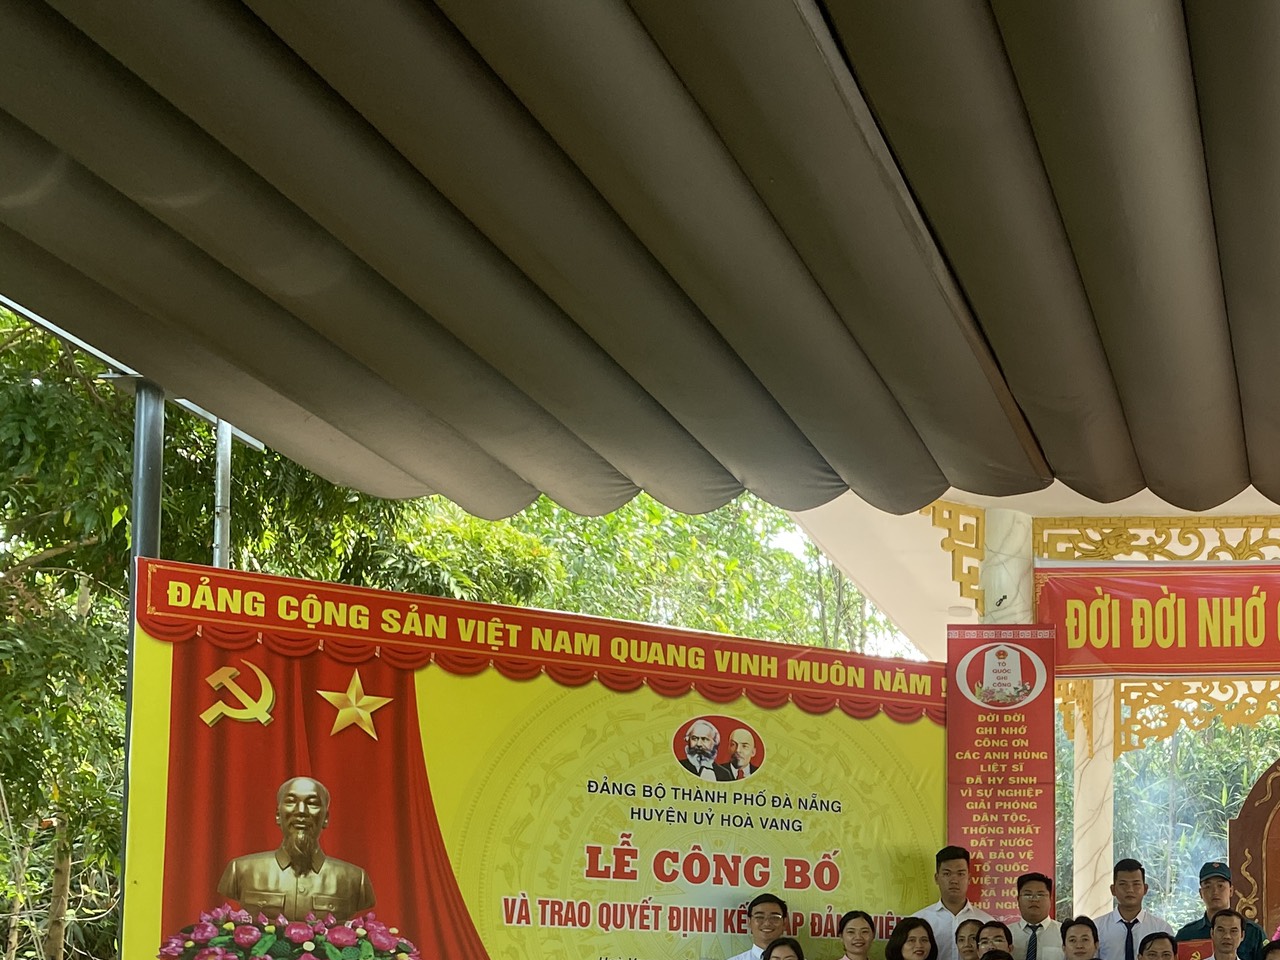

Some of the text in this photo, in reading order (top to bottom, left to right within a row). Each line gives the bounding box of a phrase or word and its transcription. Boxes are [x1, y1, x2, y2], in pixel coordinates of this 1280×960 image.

[1064, 584, 1120, 649] ĐỜI
[1131, 584, 1186, 649] ĐỜI
[1198, 584, 1267, 648] NHỚ
[167, 576, 265, 617] ĐẢNG
[277, 594, 370, 629] CỘNG
[380, 603, 447, 639] SẢN
[456, 617, 522, 650] VIỆT
[531, 628, 600, 657] NAM
[610, 637, 705, 670] QUANG
[713, 649, 778, 678] VINH
[786, 659, 866, 689] MUÔN
[873, 667, 932, 696] NĂM
[978, 712, 1026, 722] ĐỜI ĐỜI
[975, 725, 1027, 735] GHI NHỚ
[974, 737, 1010, 747] CÔNG
[955, 749, 1048, 760] CÁC ANH HÙNG
[980, 763, 1008, 774] LIỆT
[965, 774, 1037, 784] ĐÃ HY SINH
[587, 776, 842, 814] ĐẢNG BỘ THÀNH PHỐ ĐÀ NẴNG
[960, 786, 1043, 800] VÌ SỰ NGHIỆP
[966, 799, 1038, 809] GIẢI PHÓNG
[630, 807, 803, 832] HUYỆN UỶ HOÀ VANG
[972, 812, 998, 822] DÂN
[961, 823, 1005, 834] THỐNG
[999, 837, 1033, 847] NƯỚC
[989, 849, 1014, 859] BẢO
[1018, 850, 1034, 861] VỆ
[585, 833, 840, 891] LỄ CÔNG BỐ
[971, 875, 999, 885] VIỆT
[1001, 887, 1018, 898] HỘ
[973, 899, 990, 909] HỦ
[503, 892, 531, 926] VÀ
[539, 898, 591, 928] TRAO
[600, 896, 662, 935] QUYẾT
[668, 905, 716, 938] ĐỊNH
[723, 901, 750, 934] KẾ
